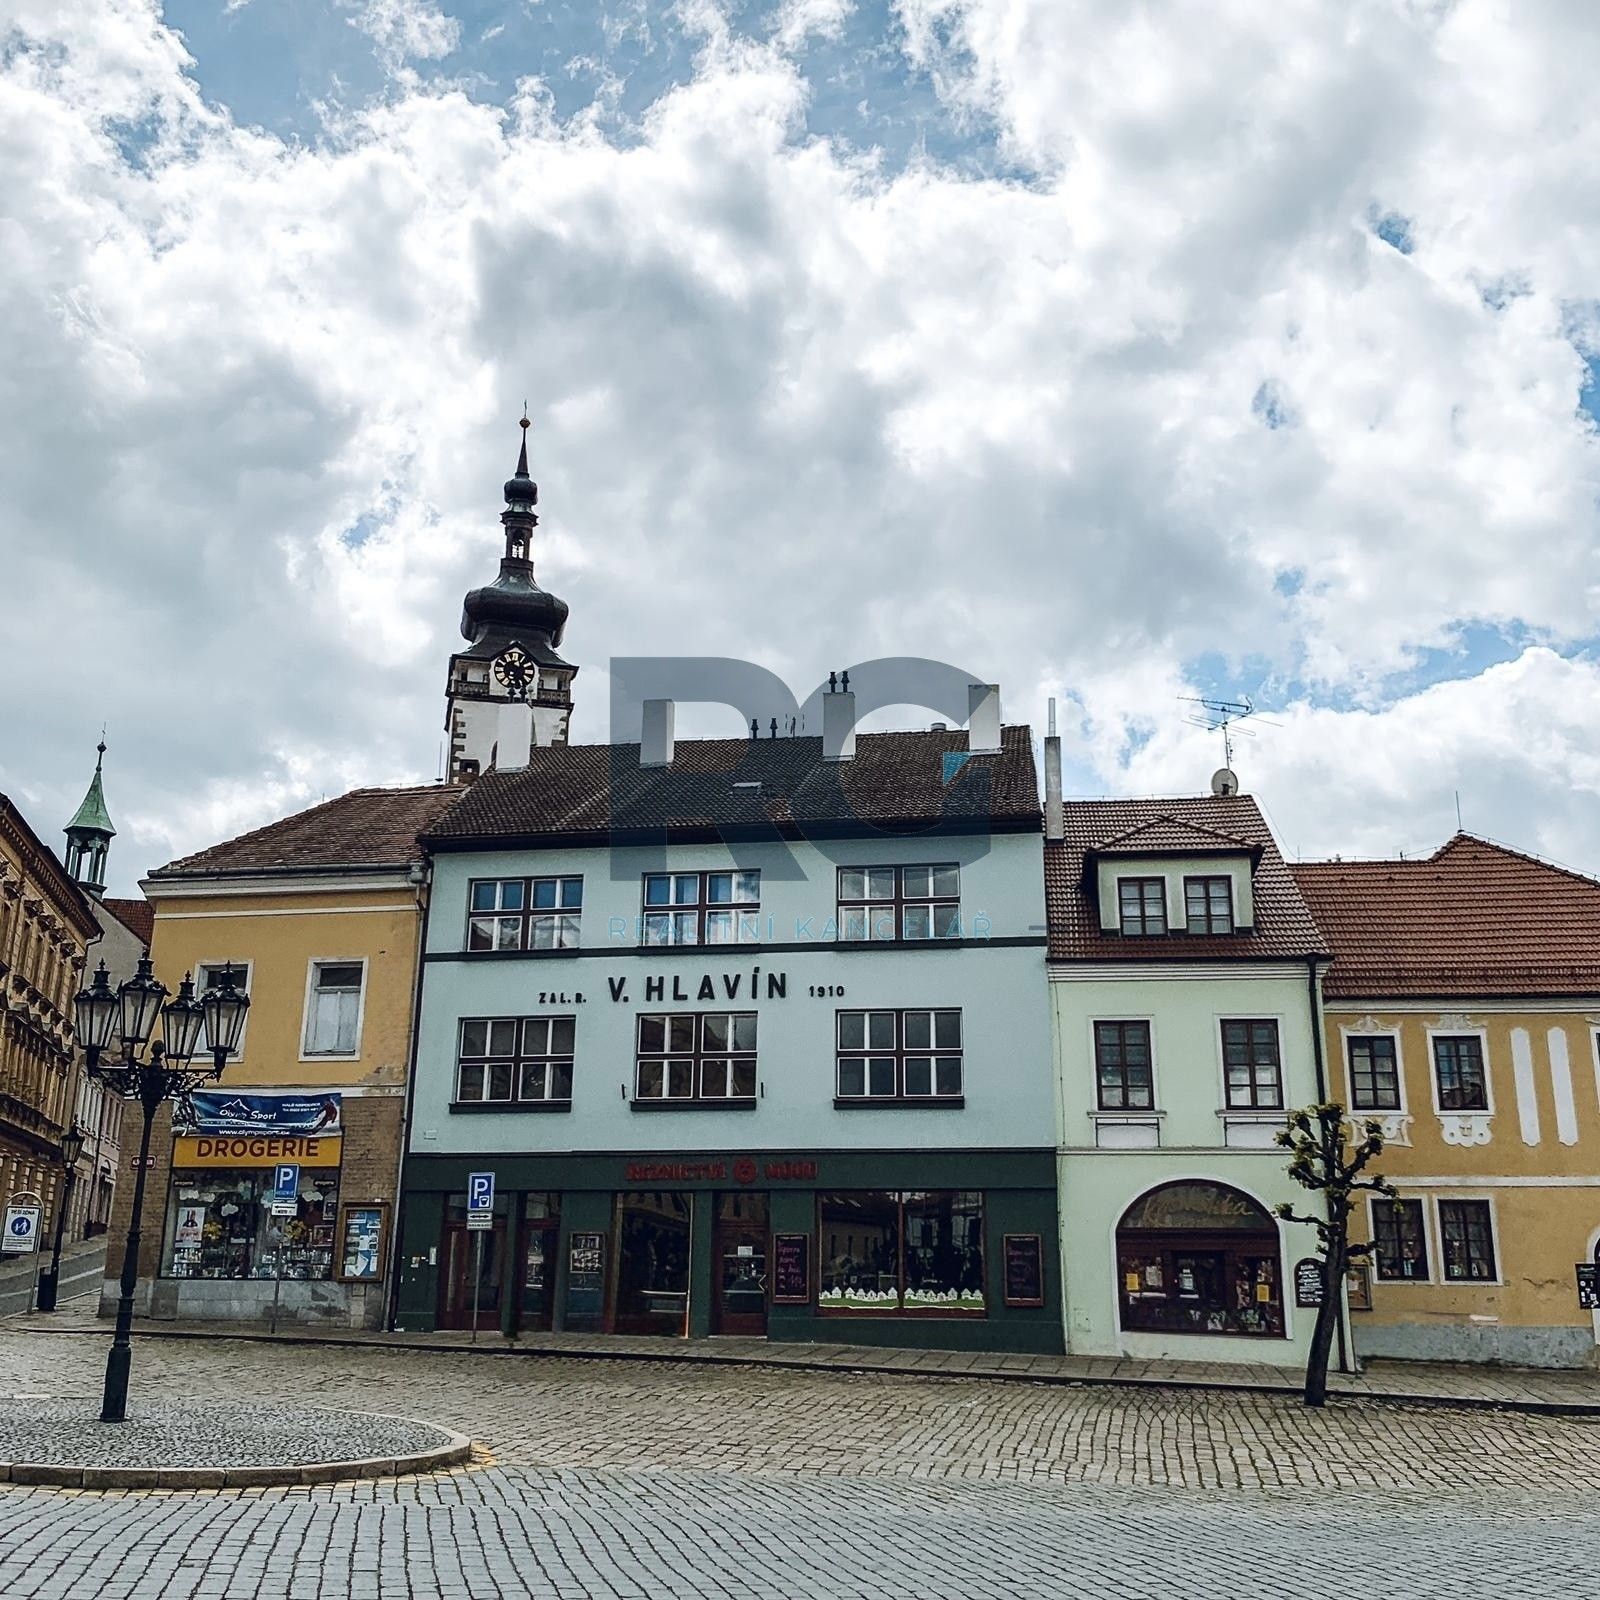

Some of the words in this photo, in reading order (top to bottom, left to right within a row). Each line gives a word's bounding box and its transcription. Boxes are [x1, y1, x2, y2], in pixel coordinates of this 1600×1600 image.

[608, 976, 629, 1003] V.
[646, 967, 786, 1001] HLAVÍN
[809, 986, 845, 997] 1910
[250, 1110, 277, 1120] Sport
[197, 1139, 319, 1157] DROGERIE
[279, 1168, 294, 1188] P
[474, 1179, 488, 1199] P
